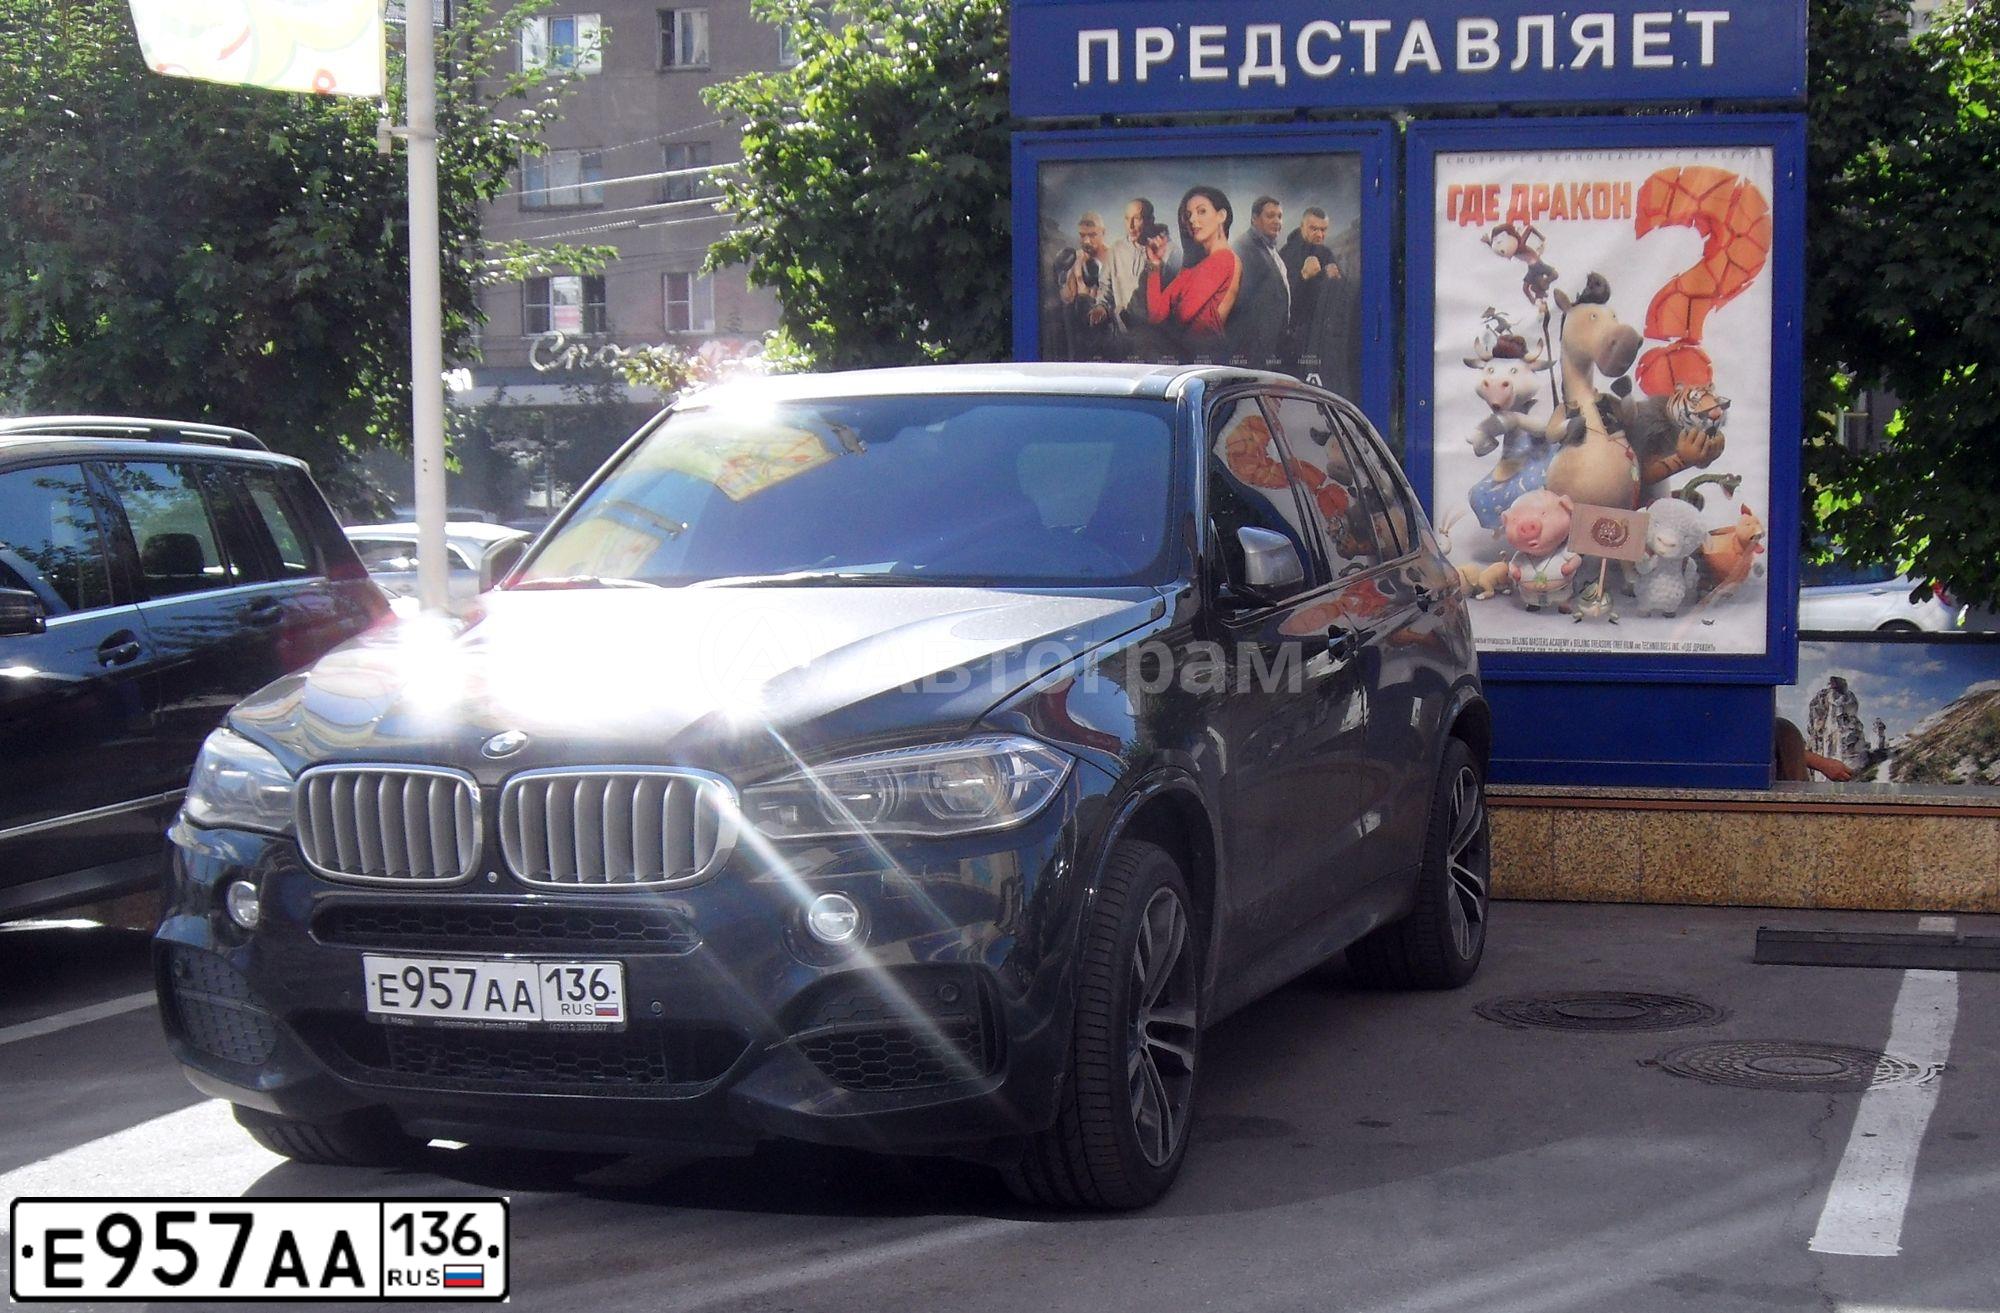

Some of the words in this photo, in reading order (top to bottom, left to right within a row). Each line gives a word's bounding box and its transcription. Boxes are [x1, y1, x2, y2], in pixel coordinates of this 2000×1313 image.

[1077, 11, 1730, 87] ПРЕДСТАВЛЯЕТ
[1446, 184, 1501, 227] ГДЕ
[1506, 181, 1632, 226] ДРАКОН
[377, 966, 535, 1013] Е957АА
[544, 968, 610, 1002] 136
[561, 1003, 593, 1016] RUS
